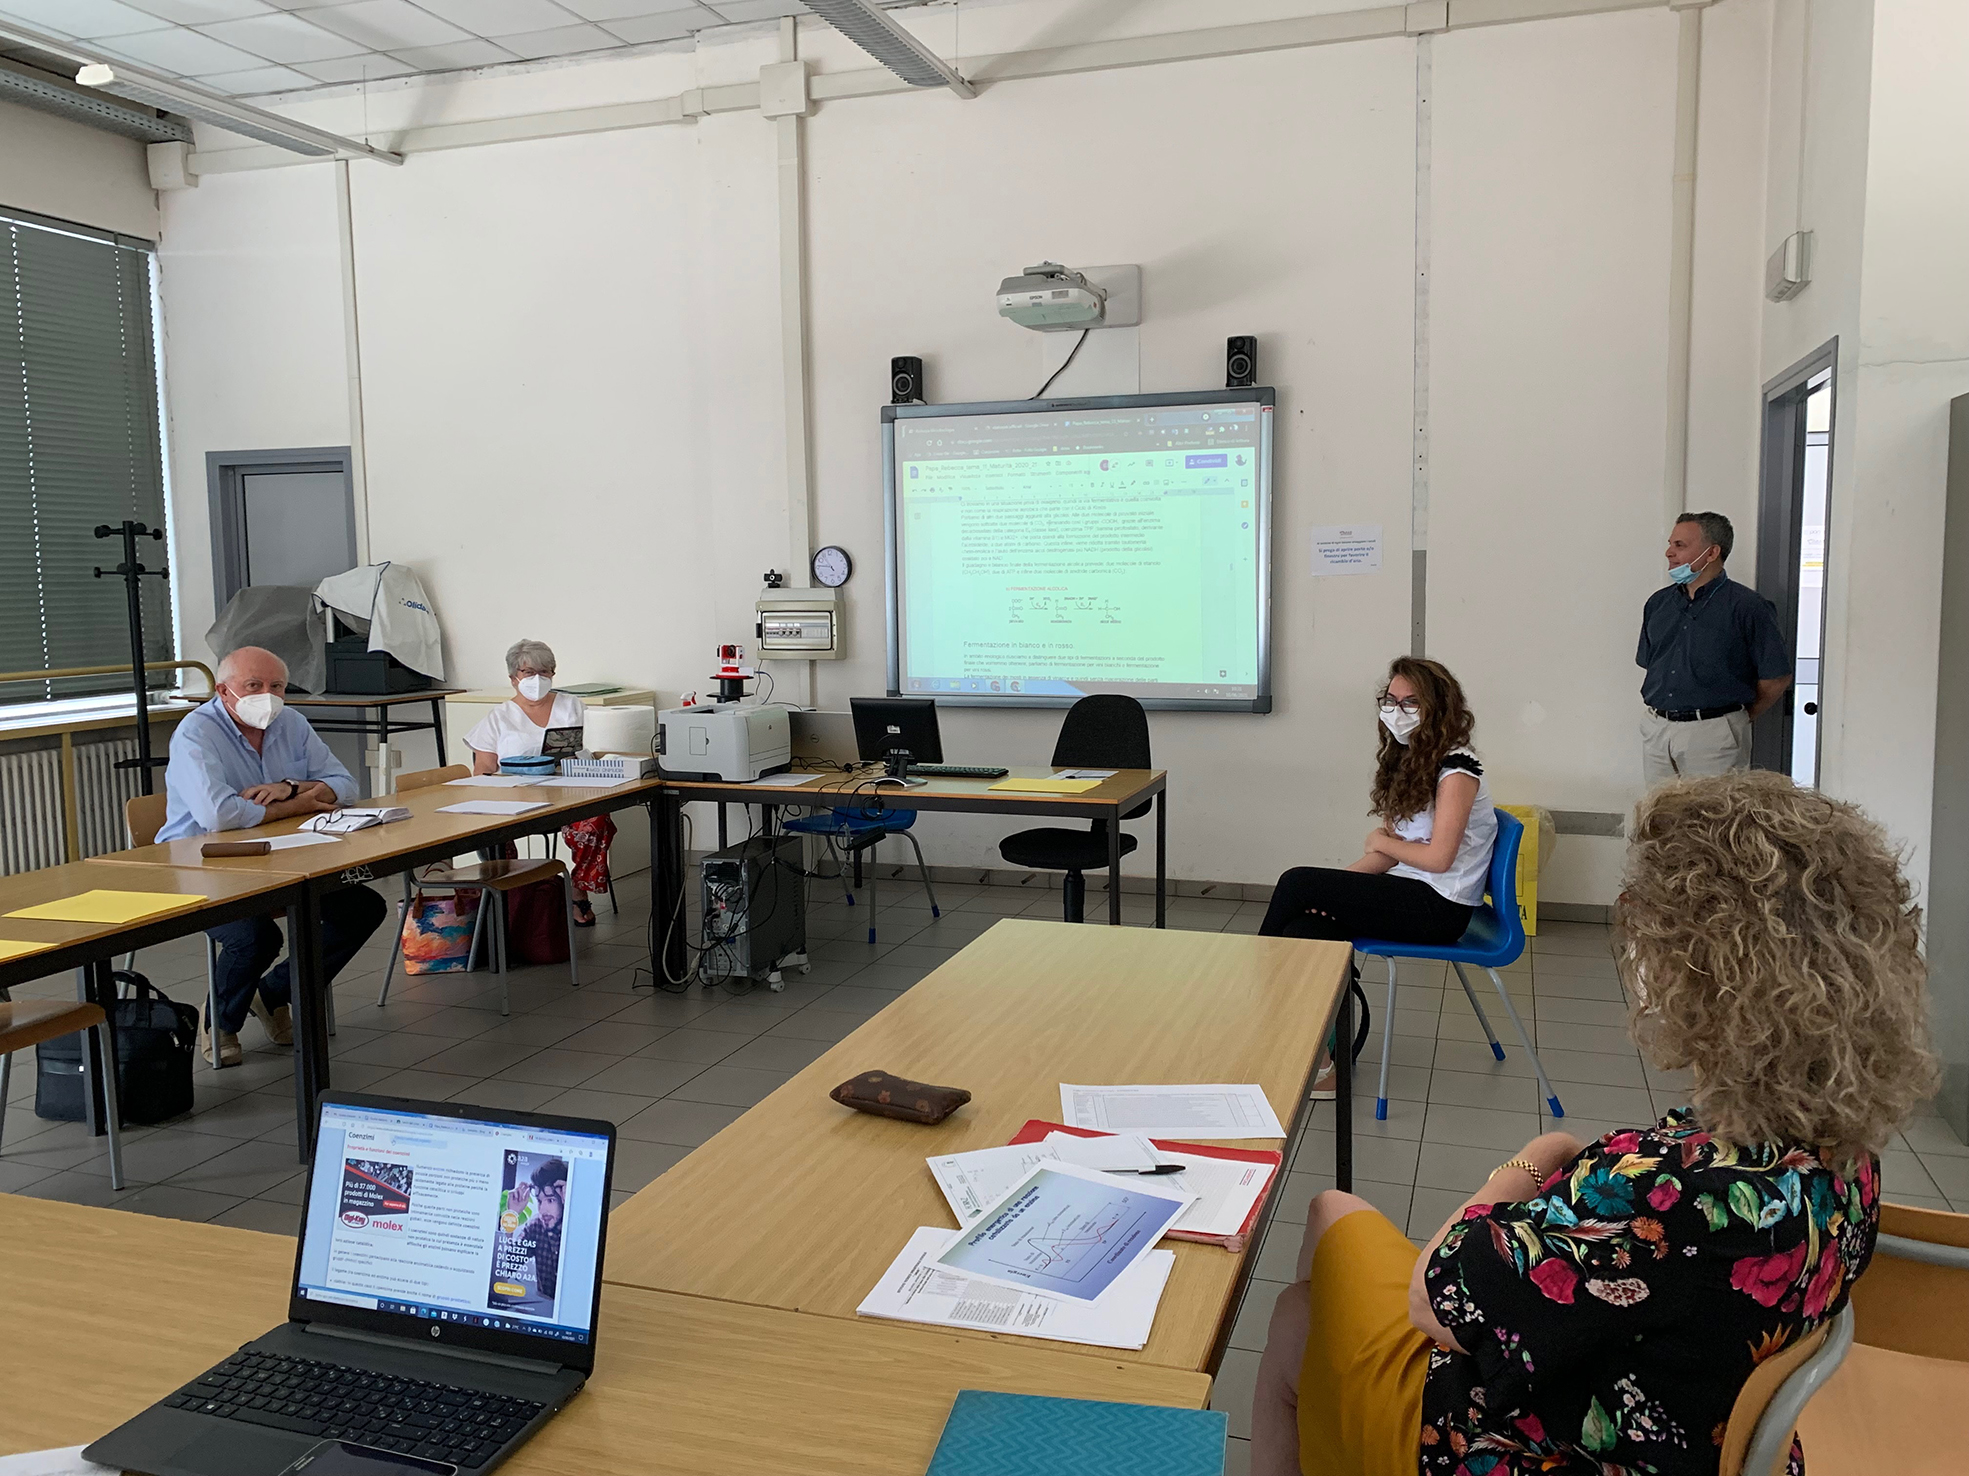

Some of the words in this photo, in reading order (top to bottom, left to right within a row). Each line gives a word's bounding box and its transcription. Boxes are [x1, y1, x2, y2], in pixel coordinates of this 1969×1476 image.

[348, 1131, 375, 1141] Coenzimi
[372, 1220, 403, 1231] molex
[499, 1236, 516, 1245] LUCE
[522, 1240, 536, 1248] GAS
[504, 1246, 527, 1255] PREZZI
[502, 1262, 528, 1272] PREZZO
[495, 1270, 521, 1280] CHIARO
